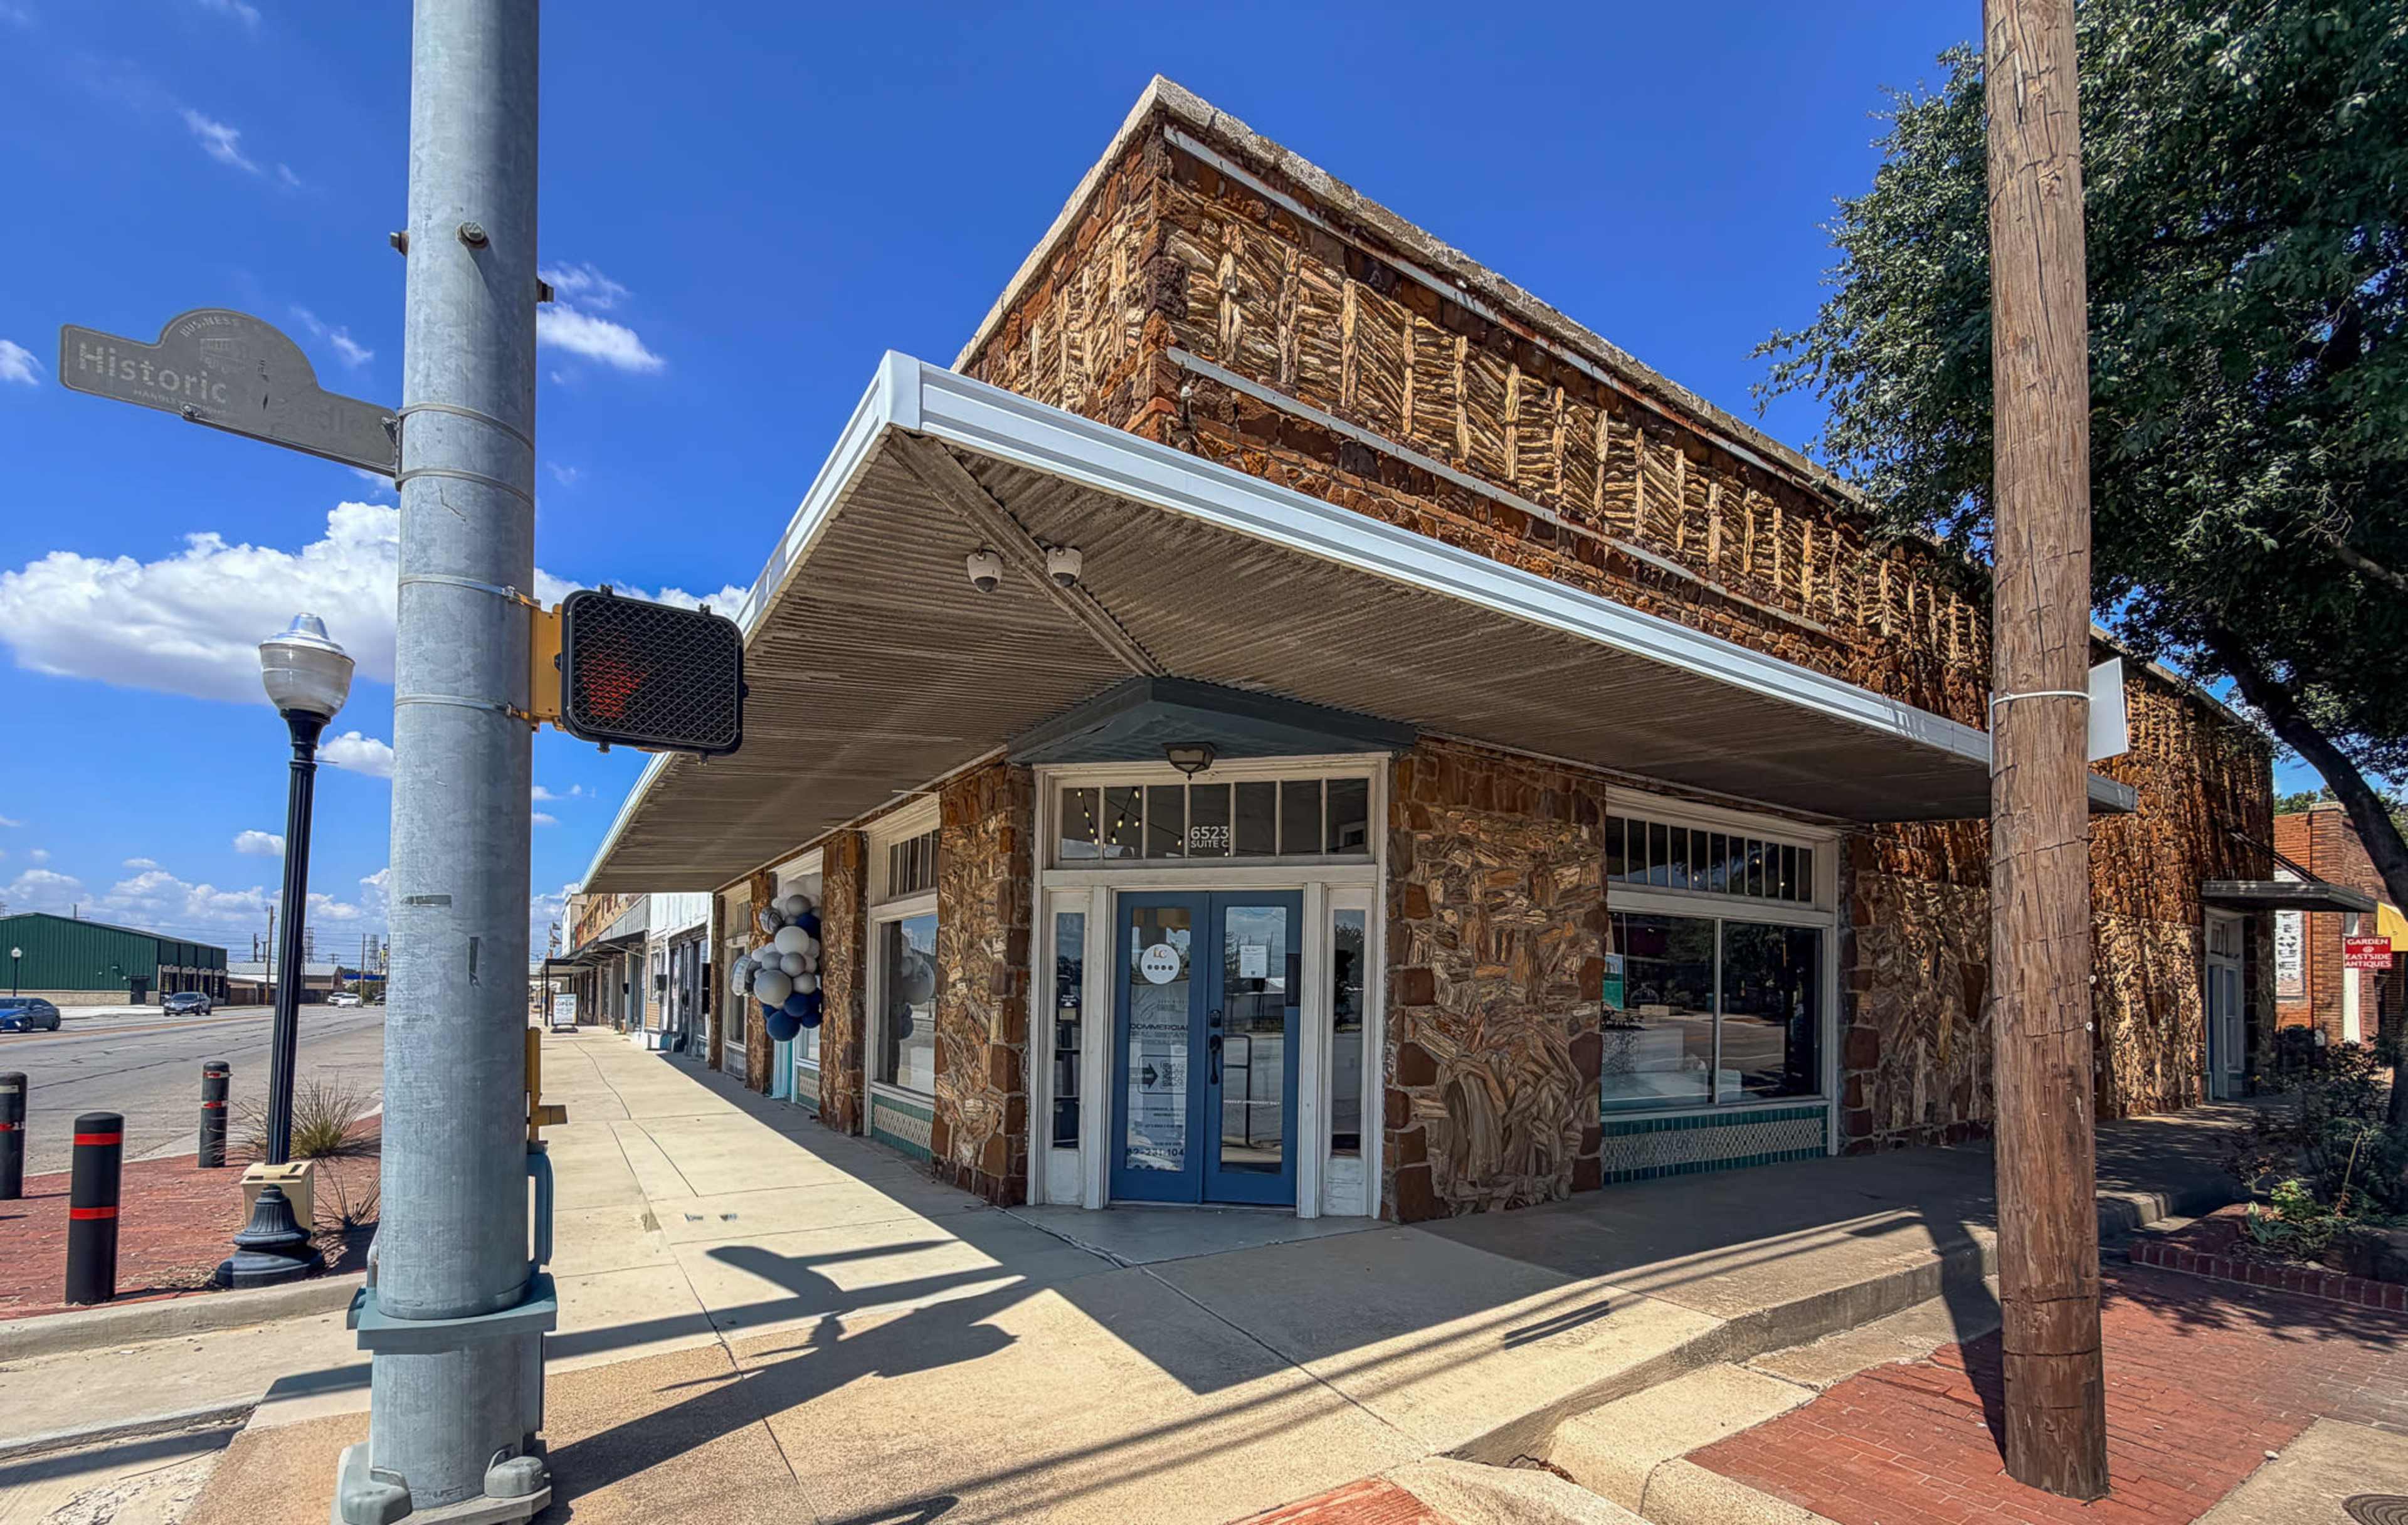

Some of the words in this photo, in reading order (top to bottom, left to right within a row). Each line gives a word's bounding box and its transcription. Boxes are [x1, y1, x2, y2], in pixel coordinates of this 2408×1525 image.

[79, 342, 226, 403] Historic
[1190, 826, 1229, 840] 6523
[1190, 840, 1219, 848] SUITE
[1221, 840, 1229, 848] C
